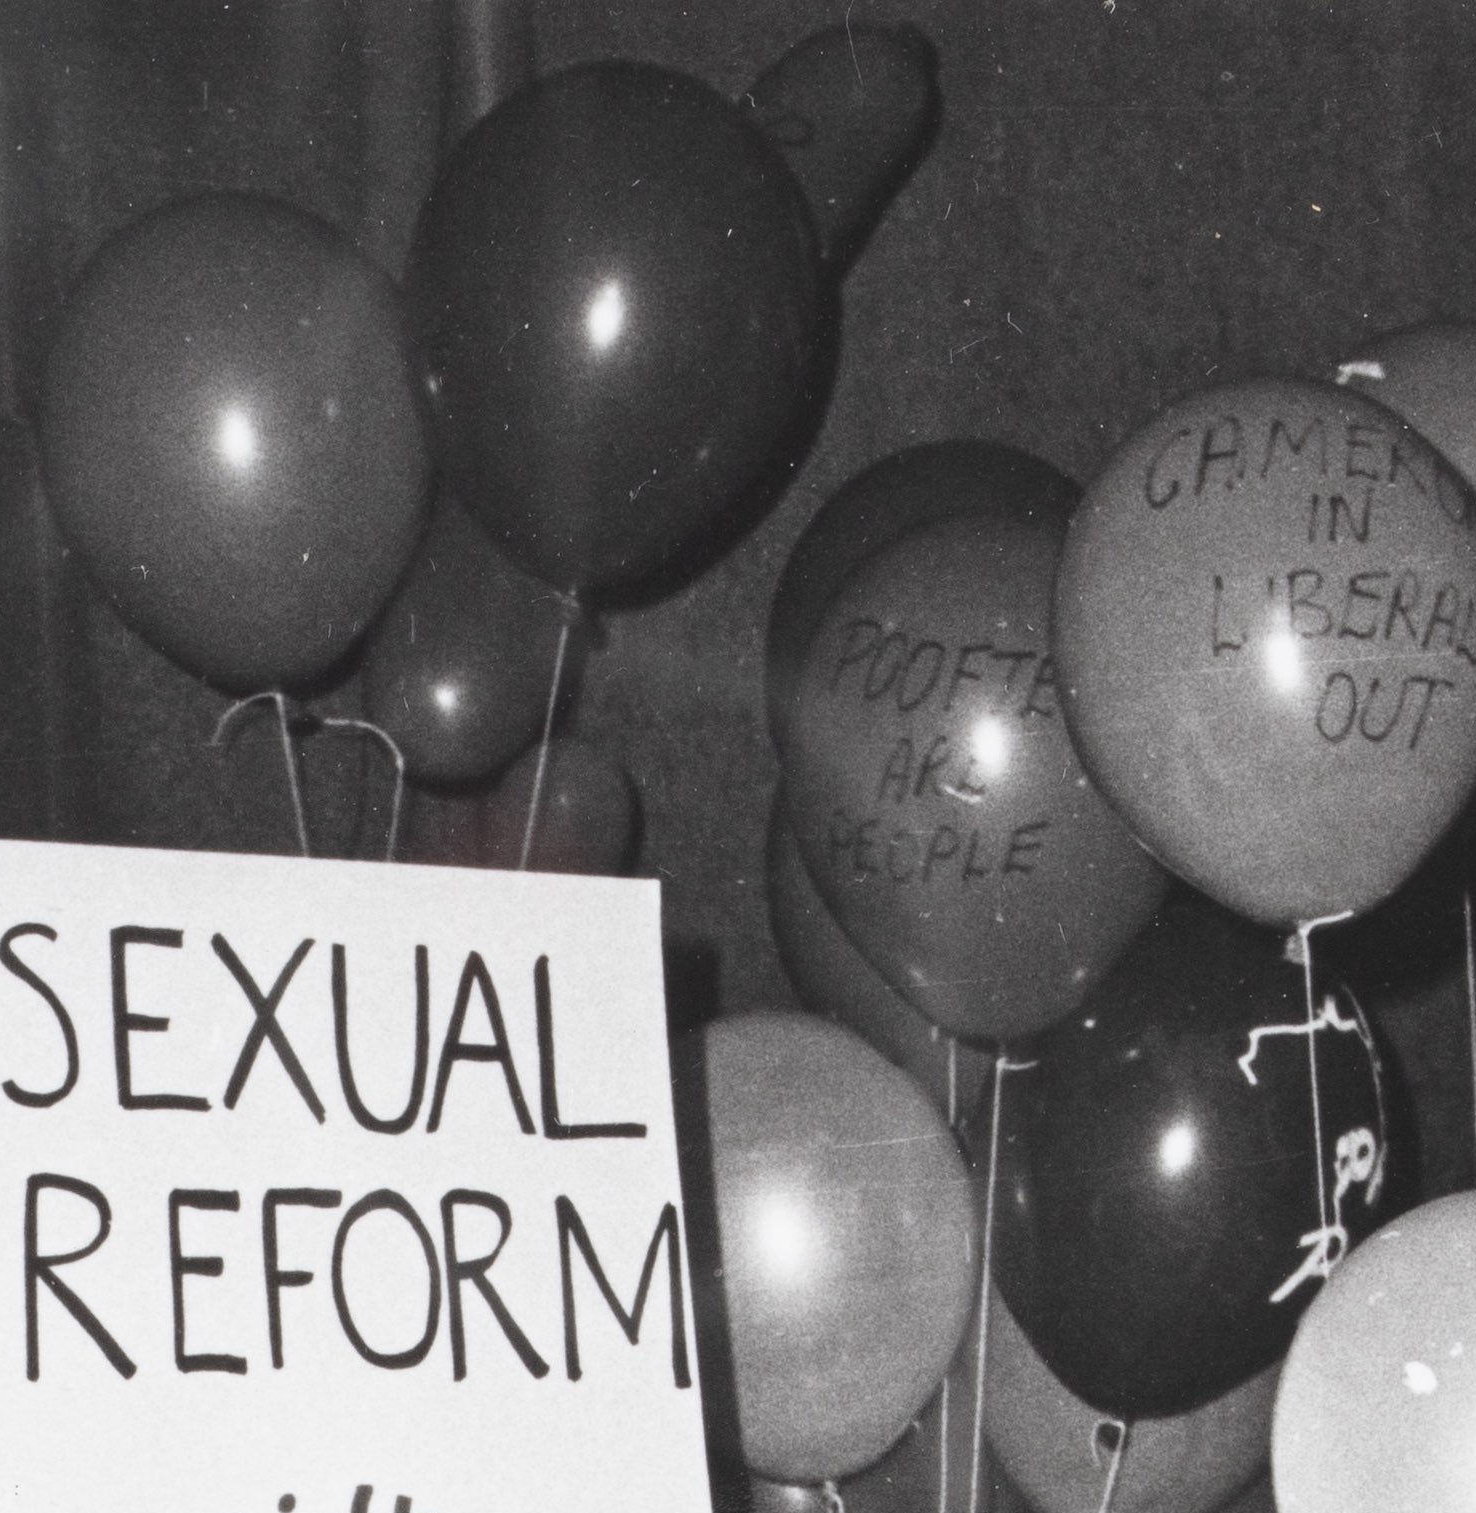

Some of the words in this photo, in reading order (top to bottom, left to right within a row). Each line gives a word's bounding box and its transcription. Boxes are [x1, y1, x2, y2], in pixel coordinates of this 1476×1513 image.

[1306, 484, 1375, 544] IN
[828, 616, 1056, 720] POOFTE
[1315, 671, 1456, 750] OUT
[827, 806, 1051, 886] PEOPLE
[22, 1173, 693, 1391] REFORM
